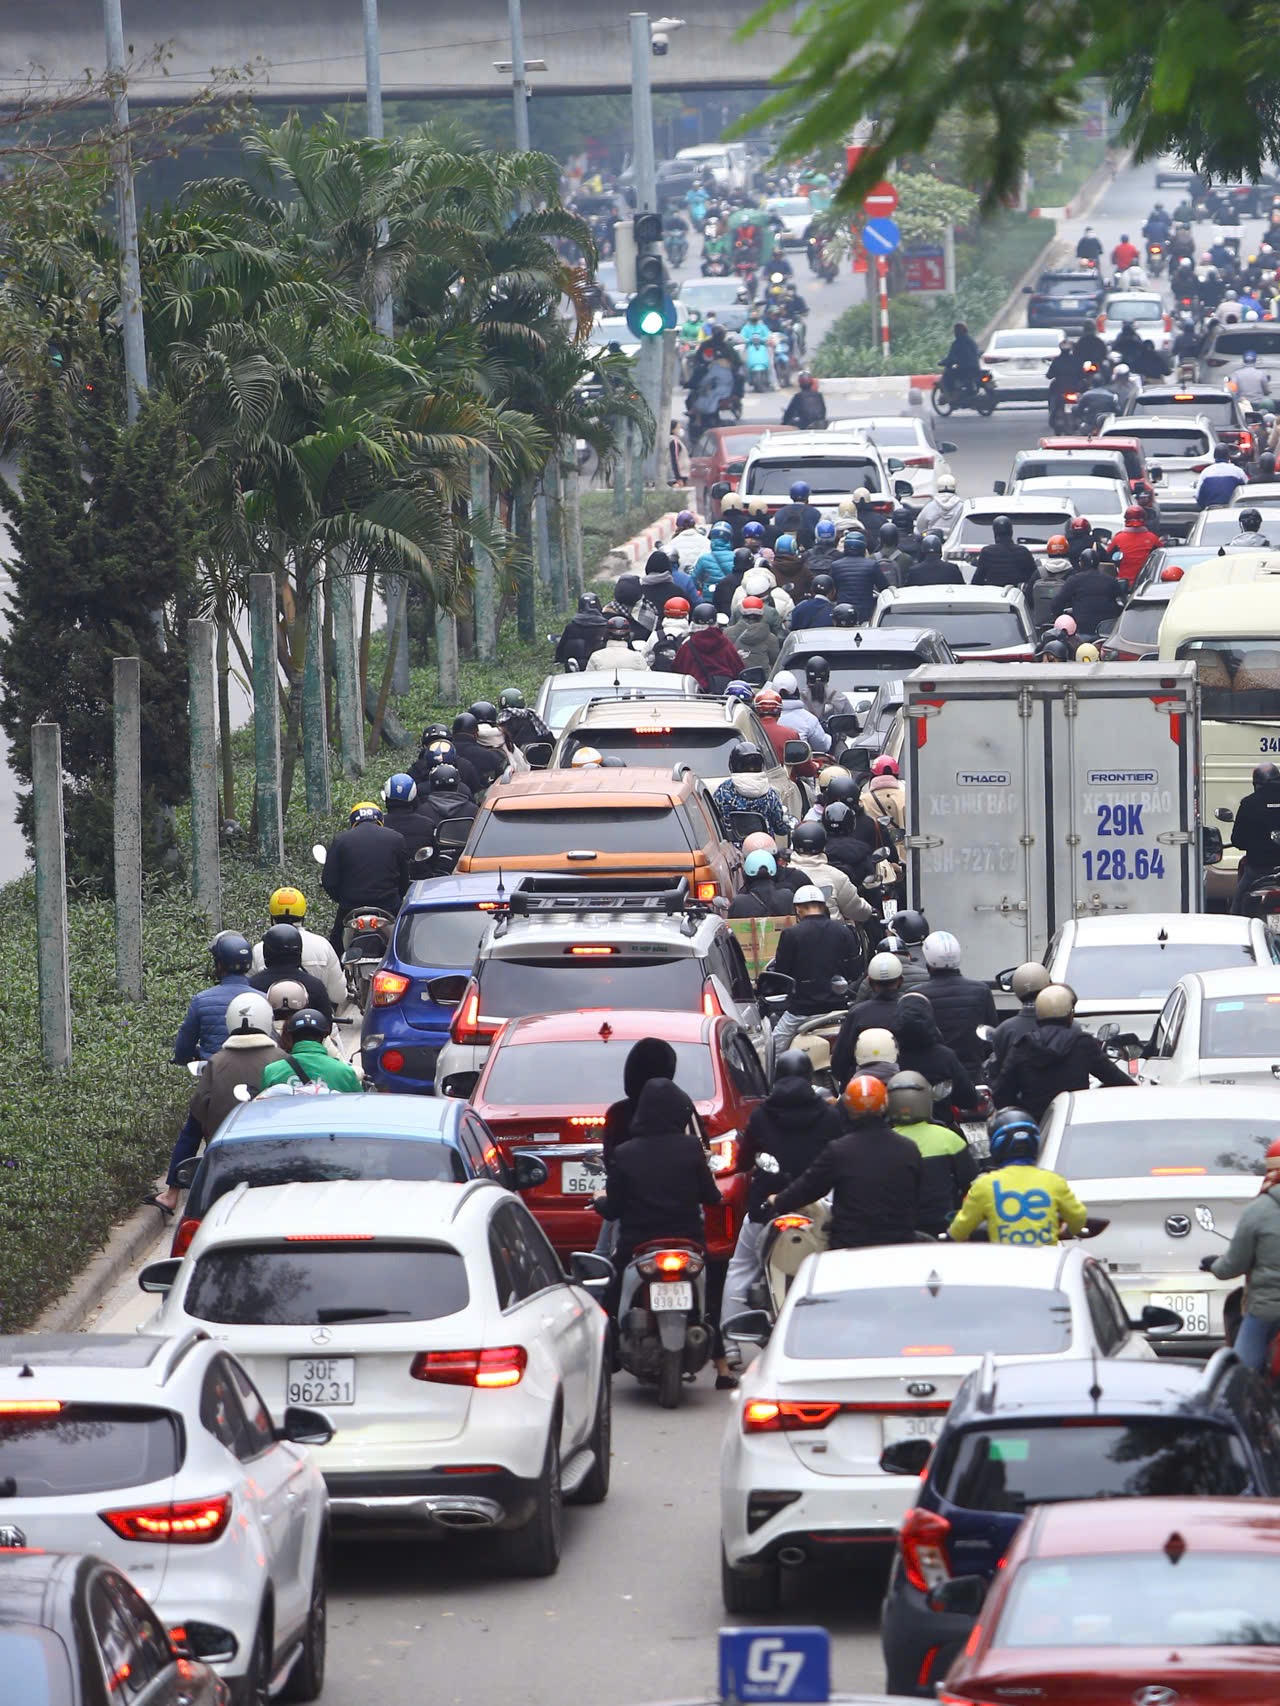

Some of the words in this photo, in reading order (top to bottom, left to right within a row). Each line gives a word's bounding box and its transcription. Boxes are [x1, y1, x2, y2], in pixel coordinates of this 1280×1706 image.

[962, 775, 1007, 783] THACO
[1091, 773, 1154, 782] FRONTIER
[1097, 804, 1144, 836] 29K
[1082, 848, 1165, 881] 128.64
[992, 1180, 1052, 1223] be
[997, 1220, 1053, 1245] Food
[1165, 1295, 1195, 1313] 30G
[304, 1360, 339, 1381] 30F
[289, 1382, 351, 1404] 962.31
[906, 1419, 938, 1436] 30K
[747, 1637, 805, 1698] G7
